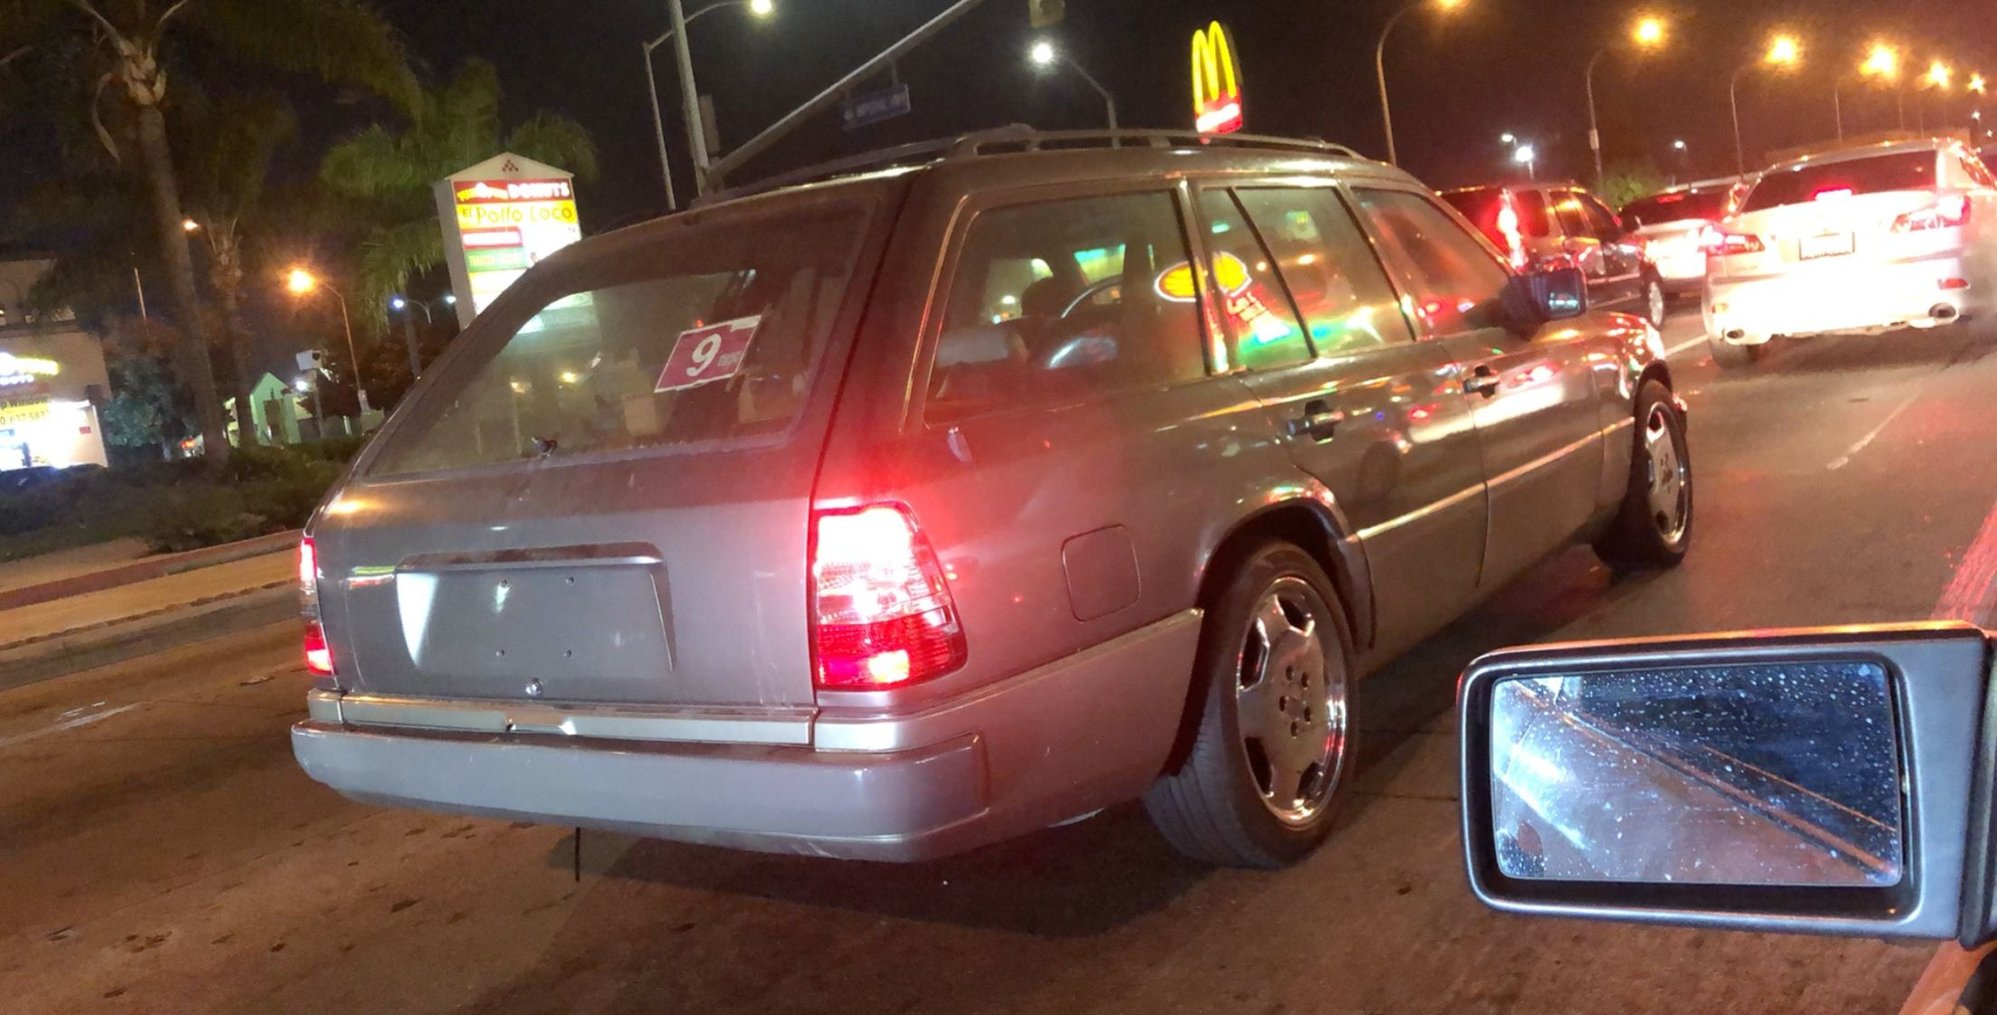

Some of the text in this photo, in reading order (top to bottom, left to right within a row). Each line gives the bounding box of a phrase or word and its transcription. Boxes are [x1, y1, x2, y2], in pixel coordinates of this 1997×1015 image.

[476, 206, 523, 224] Pollo
[530, 206, 573, 222] Loco
[686, 333, 722, 377] 9
